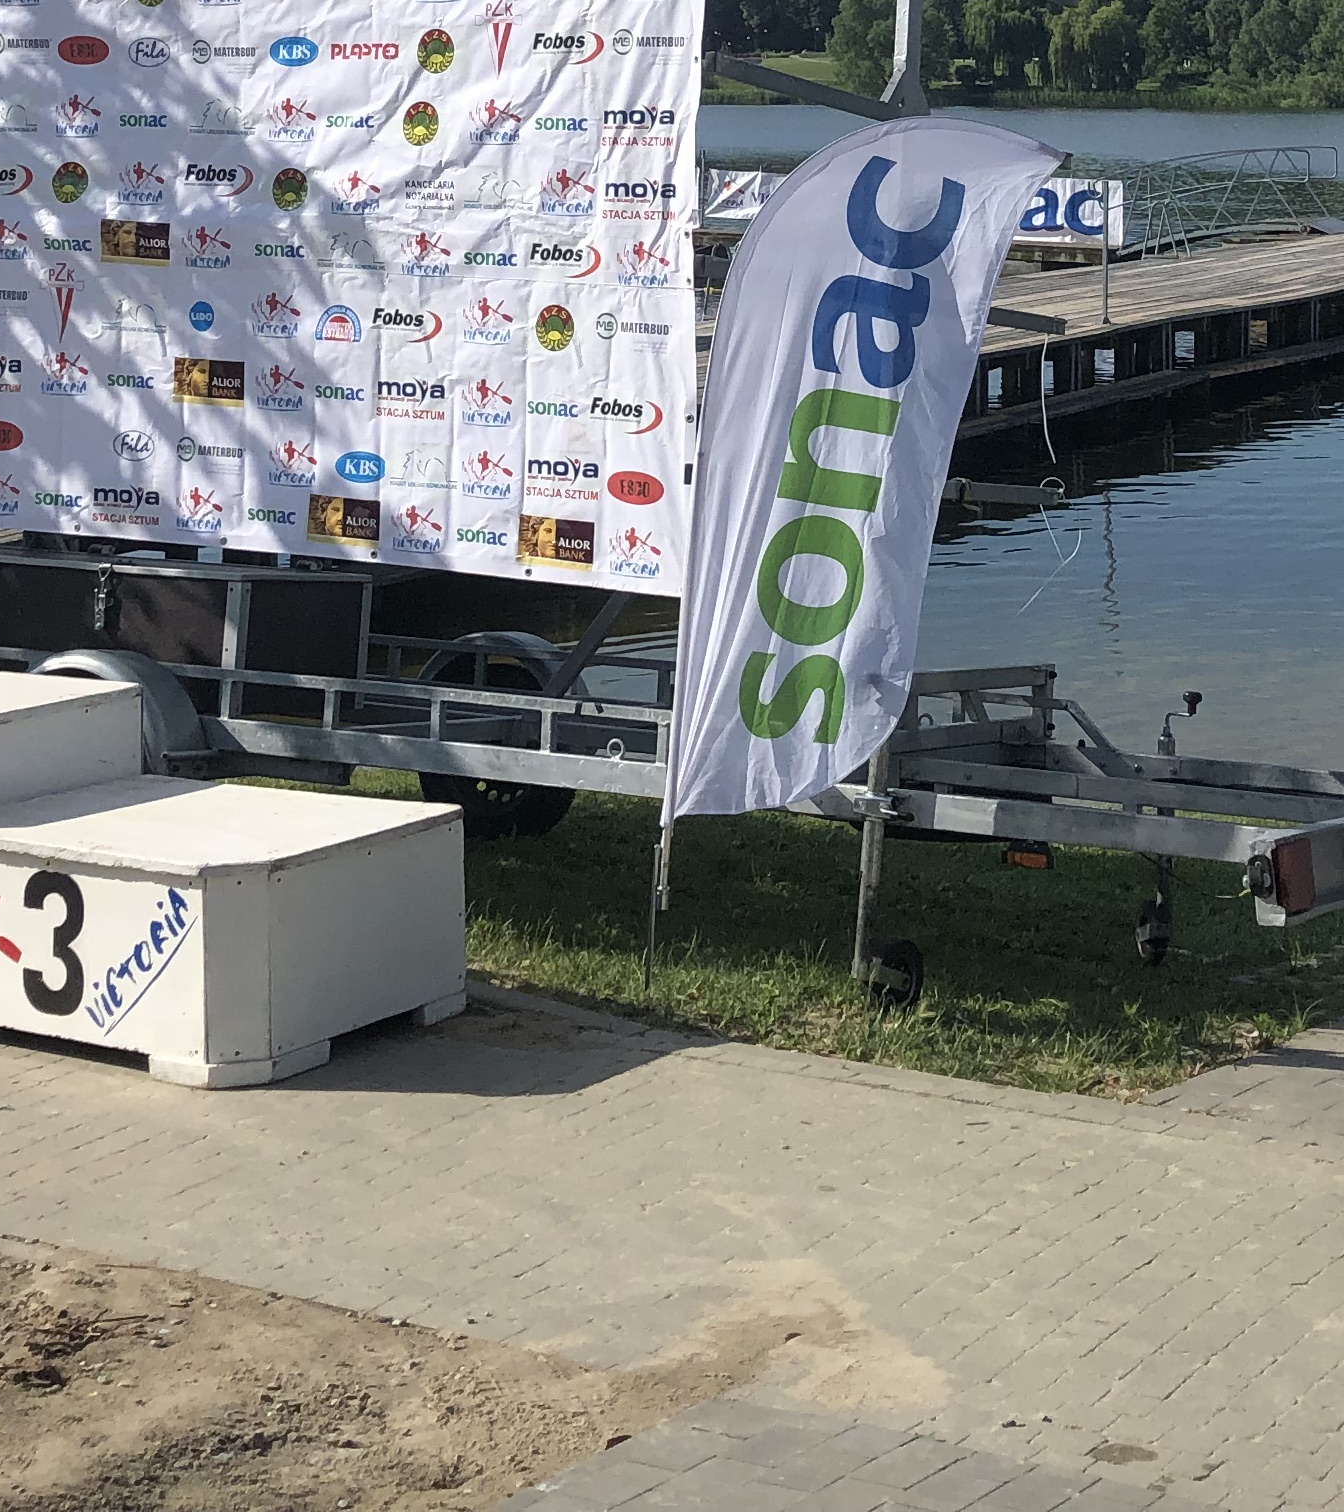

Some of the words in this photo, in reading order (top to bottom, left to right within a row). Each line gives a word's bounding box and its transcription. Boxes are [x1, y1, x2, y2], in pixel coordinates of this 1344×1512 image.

[533, 33, 585, 50] Fobos
[636, 37, 684, 47] MATERBUD
[135, 42, 166, 60] Fila
[279, 44, 311, 59] KBS
[119, 114, 167, 127] sonac
[326, 114, 374, 128] sonac
[535, 116, 588, 131] sonac
[604, 104, 674, 133] moya
[602, 137, 638, 146] STACJA
[641, 137, 674, 146] SZTUM
[185, 164, 237, 181] Fobos
[405, 180, 454, 189] KANCELARIA
[406, 192, 454, 201] NOTARIALNA
[605, 178, 675, 207] moya
[602, 210, 641, 219] STACJA
[644, 211, 675, 220] SZTUM
[44, 238, 92, 251] sonac
[139, 239, 167, 248] ALIOR
[255, 243, 304, 258] sonac
[464, 251, 517, 266] sonac
[530, 243, 583, 262] Fobos
[49, 263, 75, 281] PZK
[190, 312, 212, 321] LIDO
[372, 308, 424, 327] Fobos
[621, 322, 669, 335] MATERBUD
[108, 373, 154, 388] sonac
[212, 377, 241, 387] ALIOR
[213, 388, 237, 396] BANK
[315, 385, 364, 401] sonac
[378, 377, 445, 406] moya
[376, 407, 410, 417] STACJA
[412, 409, 445, 420] SZTUM
[528, 400, 578, 417] sonac
[590, 397, 643, 418] Fobos
[121, 435, 152, 454] Fila
[198, 446, 242, 458] MATERBUD
[739, 154, 965, 744] sonac
[344, 459, 379, 477] KBS
[528, 456, 598, 486] moya
[35, 492, 82, 508] sonac
[93, 485, 159, 512] moya
[526, 487, 562, 498] STACJA
[565, 489, 598, 500] SZTUM
[92, 513, 126, 523] STACJA
[129, 515, 159, 525] SZTUM
[247, 508, 296, 525] sonac
[346, 516, 376, 527] ALIOR
[346, 527, 371, 537] BANK
[457, 527, 507, 546] sonac
[558, 537, 590, 550] ALIOR
[559, 549, 585, 560] BANK
[22, 870, 85, 1016] 3
